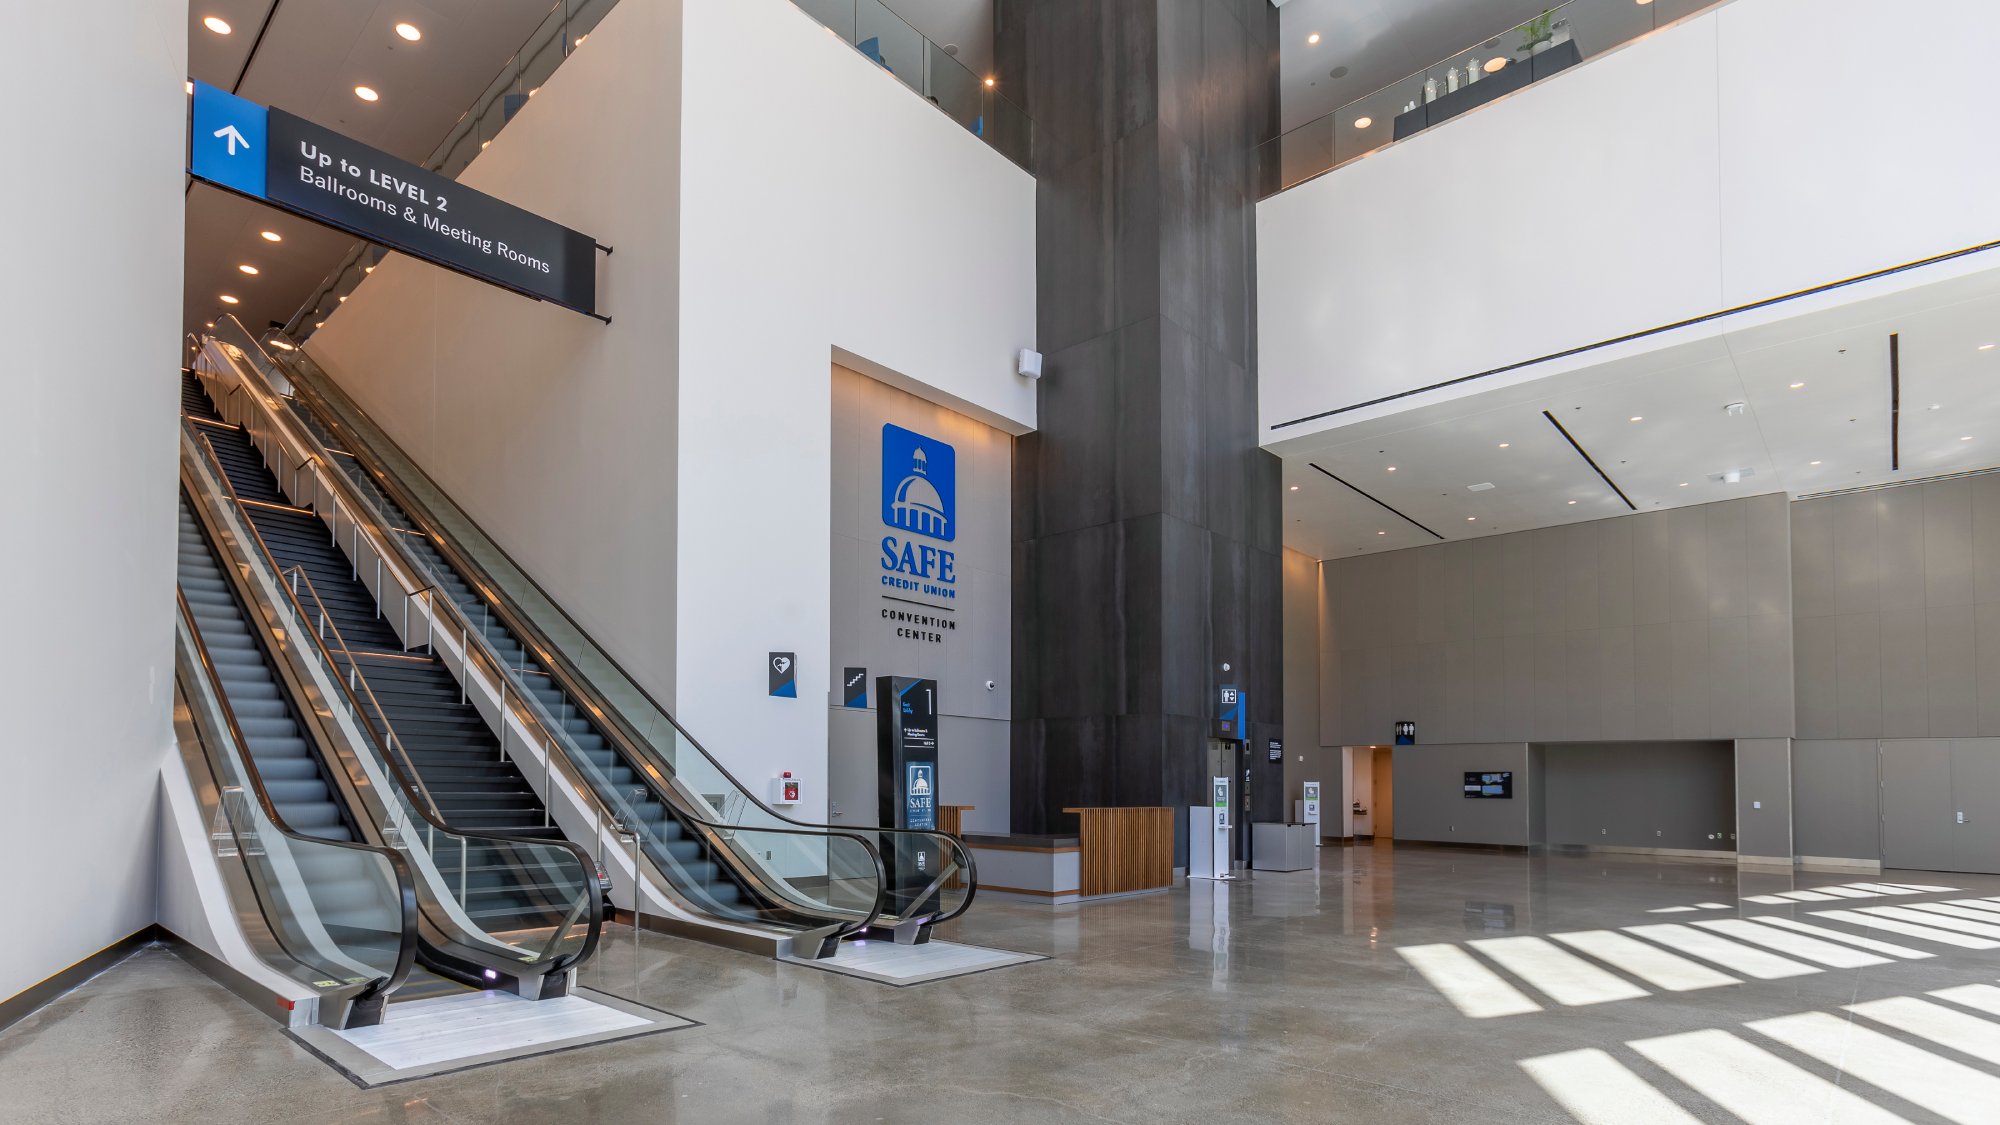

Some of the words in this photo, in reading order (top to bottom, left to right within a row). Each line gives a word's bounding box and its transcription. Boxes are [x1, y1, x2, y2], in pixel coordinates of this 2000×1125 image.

[301, 141, 332, 168] Up
[340, 158, 361, 178] to
[370, 169, 429, 206] LEVEL
[436, 195, 448, 213] 2
[300, 166, 397, 217] Ballrooms
[403, 206, 417, 224] &
[423, 213, 492, 255] Meeting
[497, 242, 550, 274] Rooms
[881, 536, 956, 584] SAFE
[881, 575, 919, 592] CREDIT
[923, 584, 956, 599] UNION
[881, 608, 956, 631] CONVENTION
[897, 627, 942, 644] CENTER
[910, 797, 931, 809] SAFE
